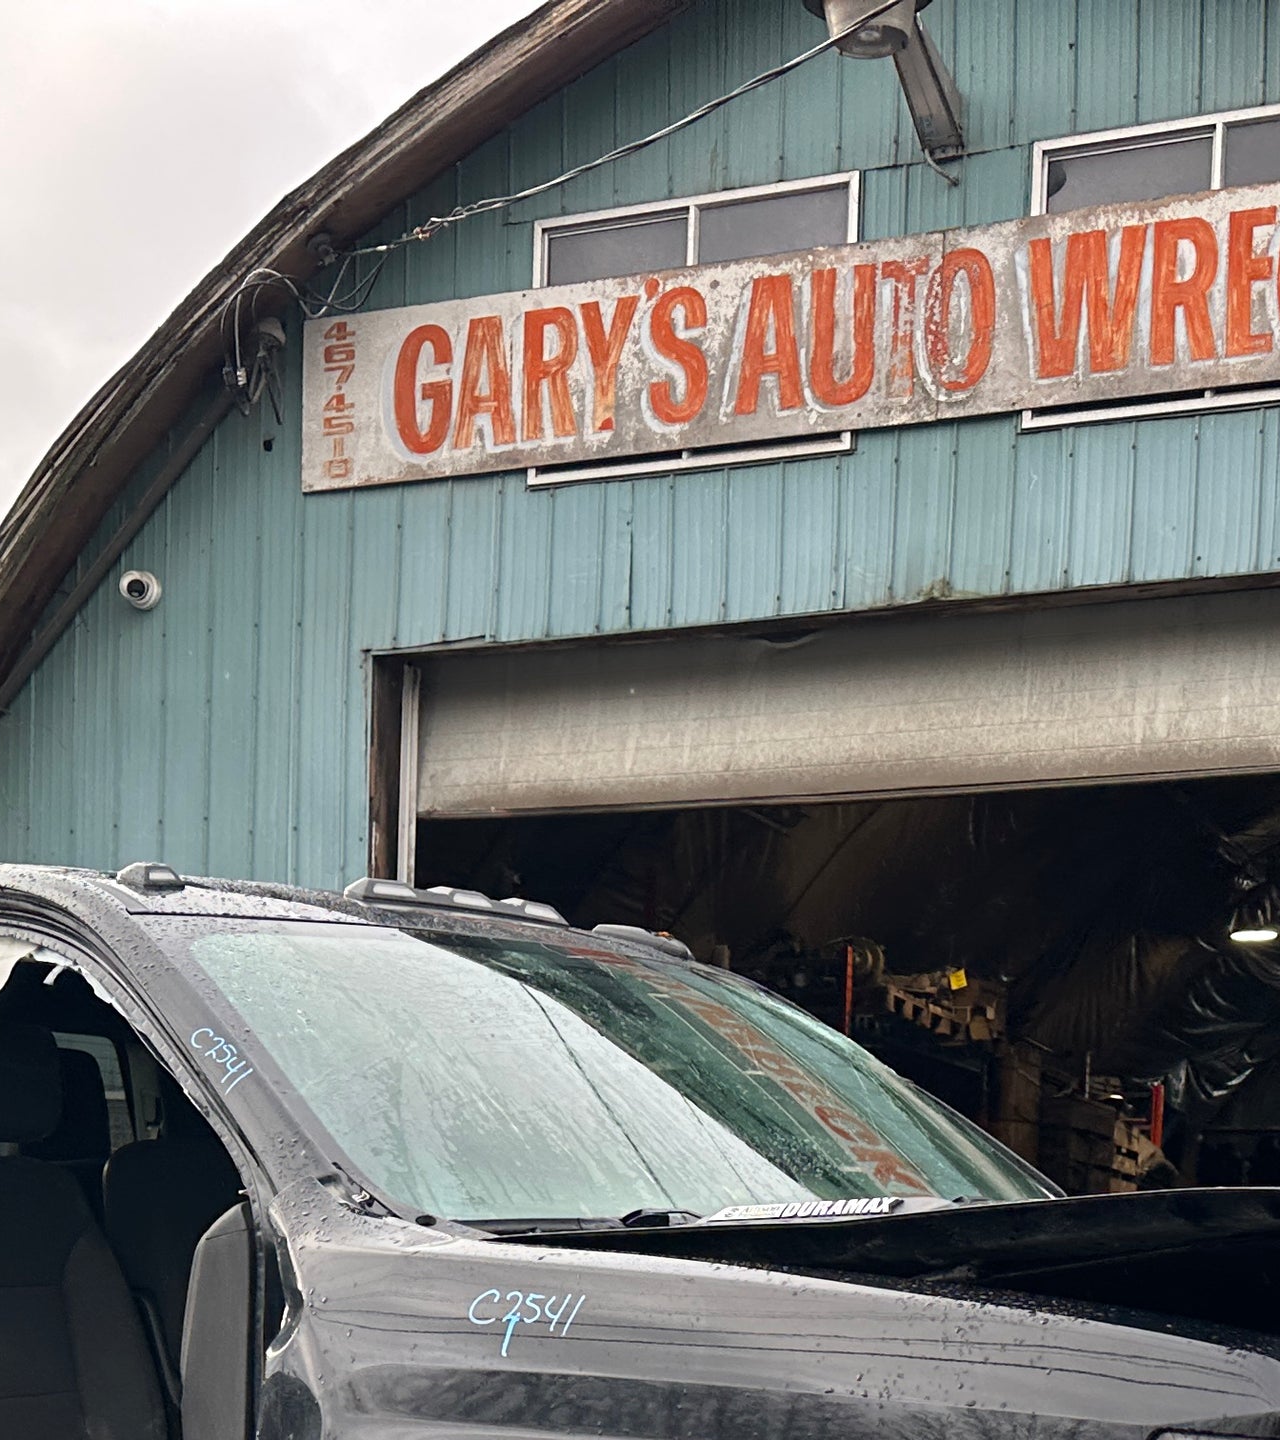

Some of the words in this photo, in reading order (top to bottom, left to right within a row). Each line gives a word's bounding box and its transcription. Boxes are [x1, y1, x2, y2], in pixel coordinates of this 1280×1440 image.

[393, 278, 708, 455] GARY'S
[734, 247, 996, 416] AUTO
[190, 1027, 253, 1096] C2541
[781, 1196, 904, 1217] DURAMAX
